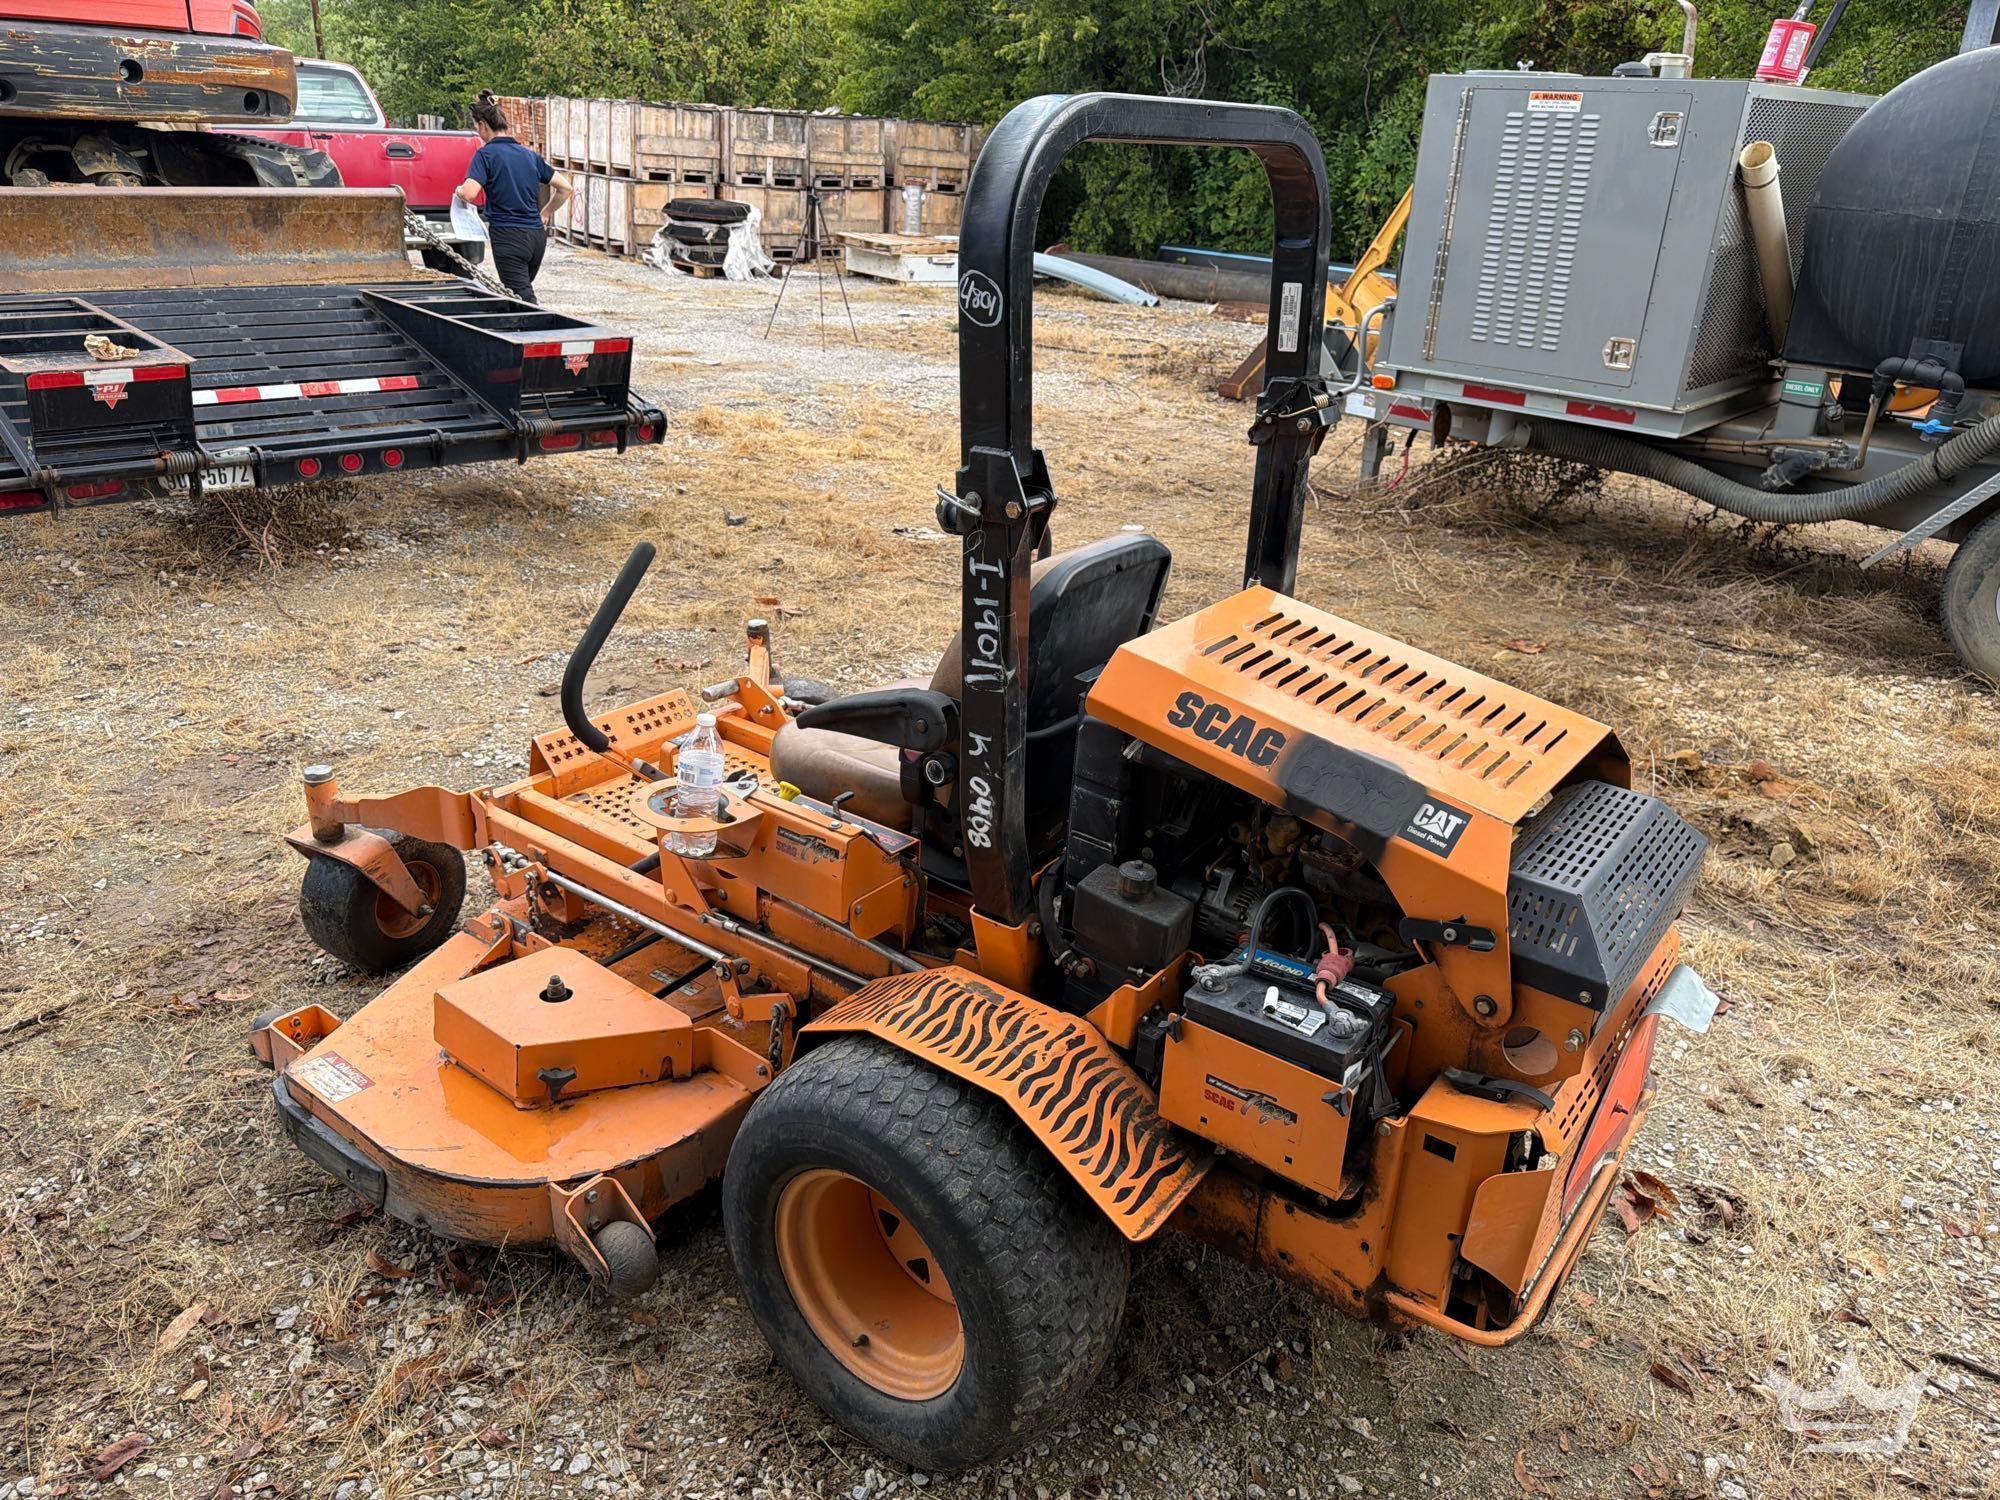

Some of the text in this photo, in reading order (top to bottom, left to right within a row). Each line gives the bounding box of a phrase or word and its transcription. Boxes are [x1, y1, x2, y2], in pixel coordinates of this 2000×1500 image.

[1542, 92, 1578, 101] WARNING
[1785, 383, 1820, 394] DIESEL ONLY
[1166, 691, 1288, 767] SCAG
[1413, 803, 1463, 839] CAT
[1406, 825, 1448, 848] Diesel Power
[1254, 955, 1305, 978] LEGEND
[336, 1062, 368, 1087] DANGER
